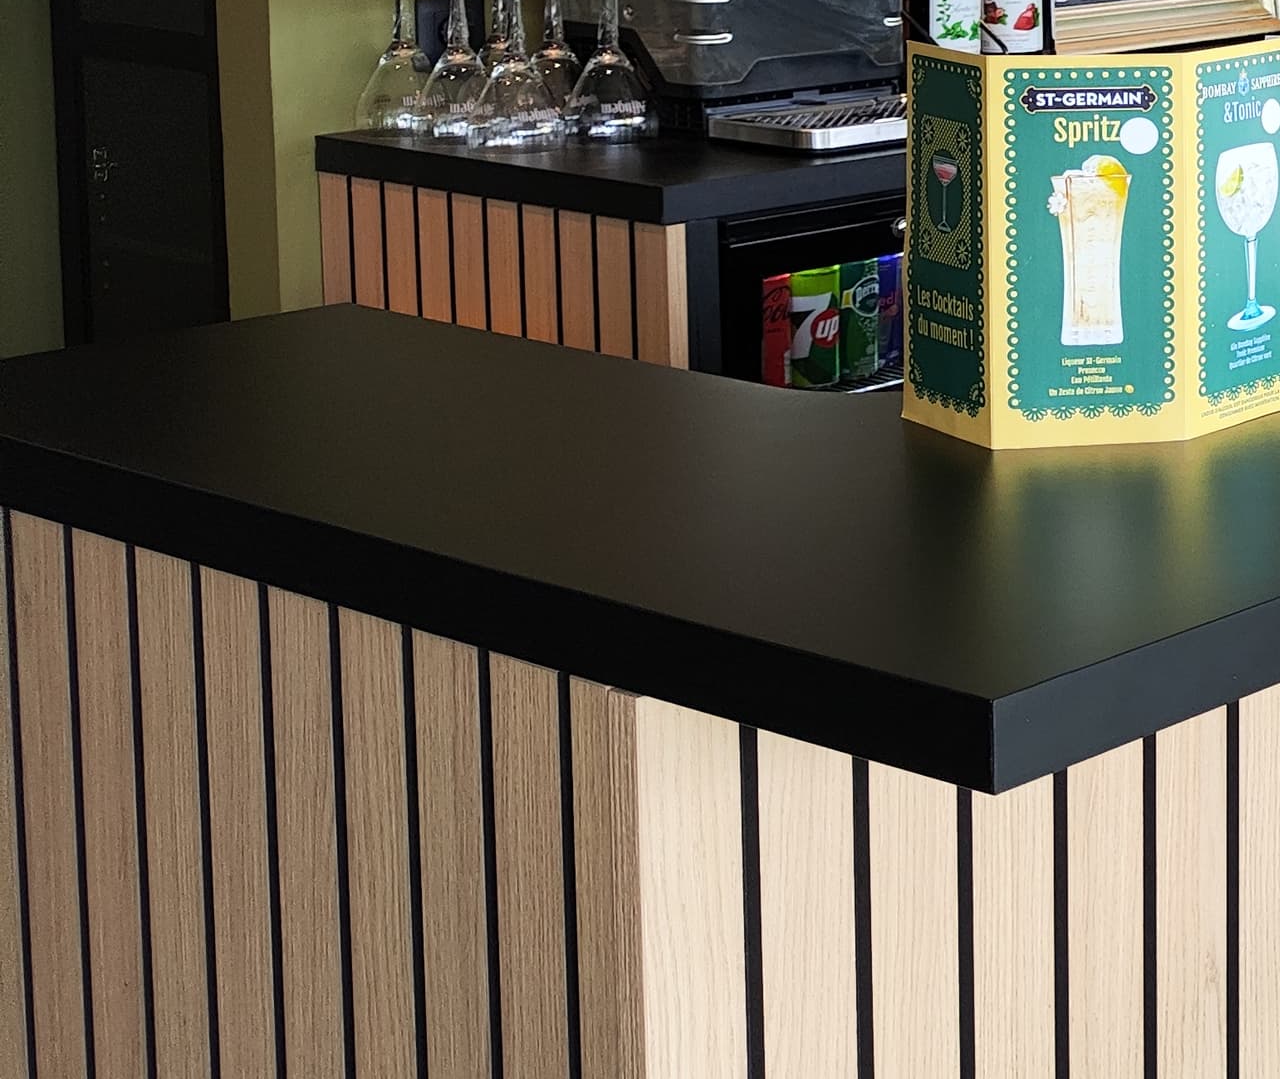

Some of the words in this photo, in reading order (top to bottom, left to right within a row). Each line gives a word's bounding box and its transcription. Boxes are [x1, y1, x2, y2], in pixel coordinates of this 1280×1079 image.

[1035, 91, 1144, 108] ST-GERMAIN
[1201, 81, 1237, 100] BOMBAY
[1223, 98, 1262, 124] &Tonic
[1053, 115, 1121, 148] Spritz
[917, 284, 931, 308] Les
[932, 289, 974, 321] Cocktails
[917, 313, 929, 336] du
[930, 321, 968, 349] moment
